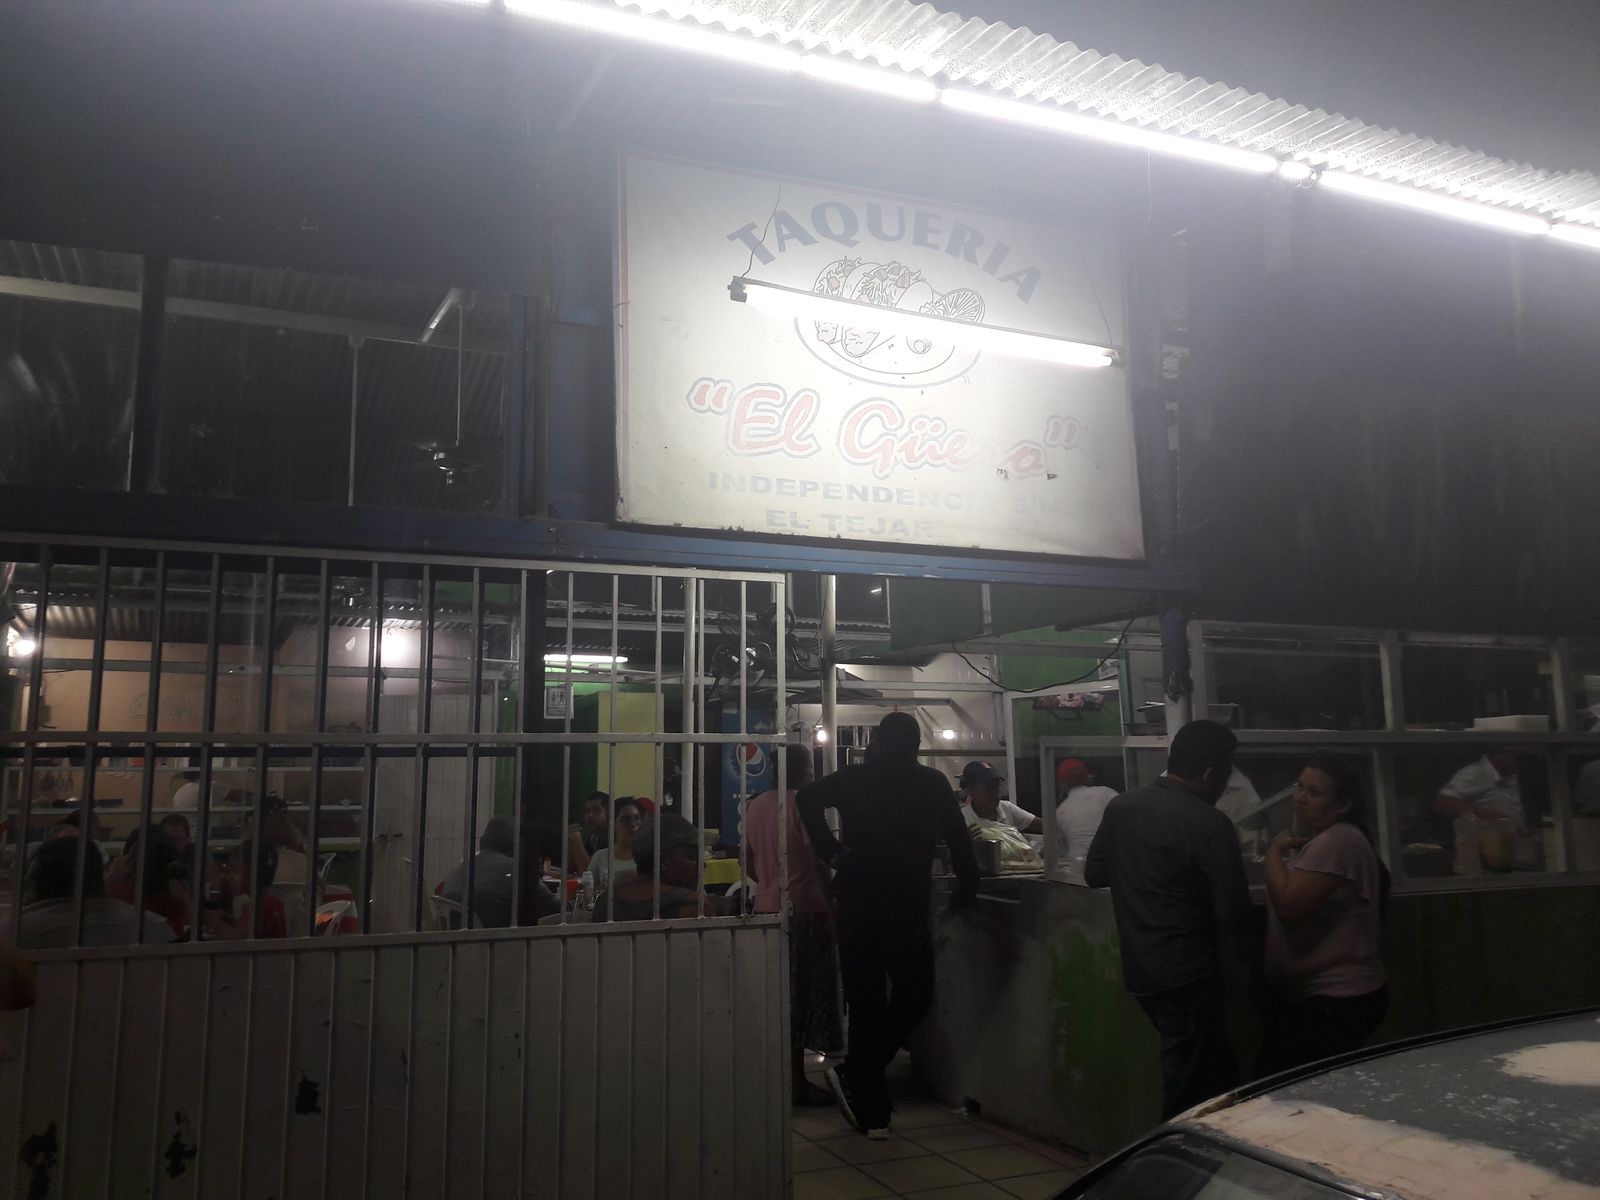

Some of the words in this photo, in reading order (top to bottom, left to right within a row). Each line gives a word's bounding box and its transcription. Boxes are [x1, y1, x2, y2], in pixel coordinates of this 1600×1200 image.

[725, 200, 1042, 305] TAQUERIA
[766, 508, 810, 530] EL
[820, 512, 933, 539] TEJAR
